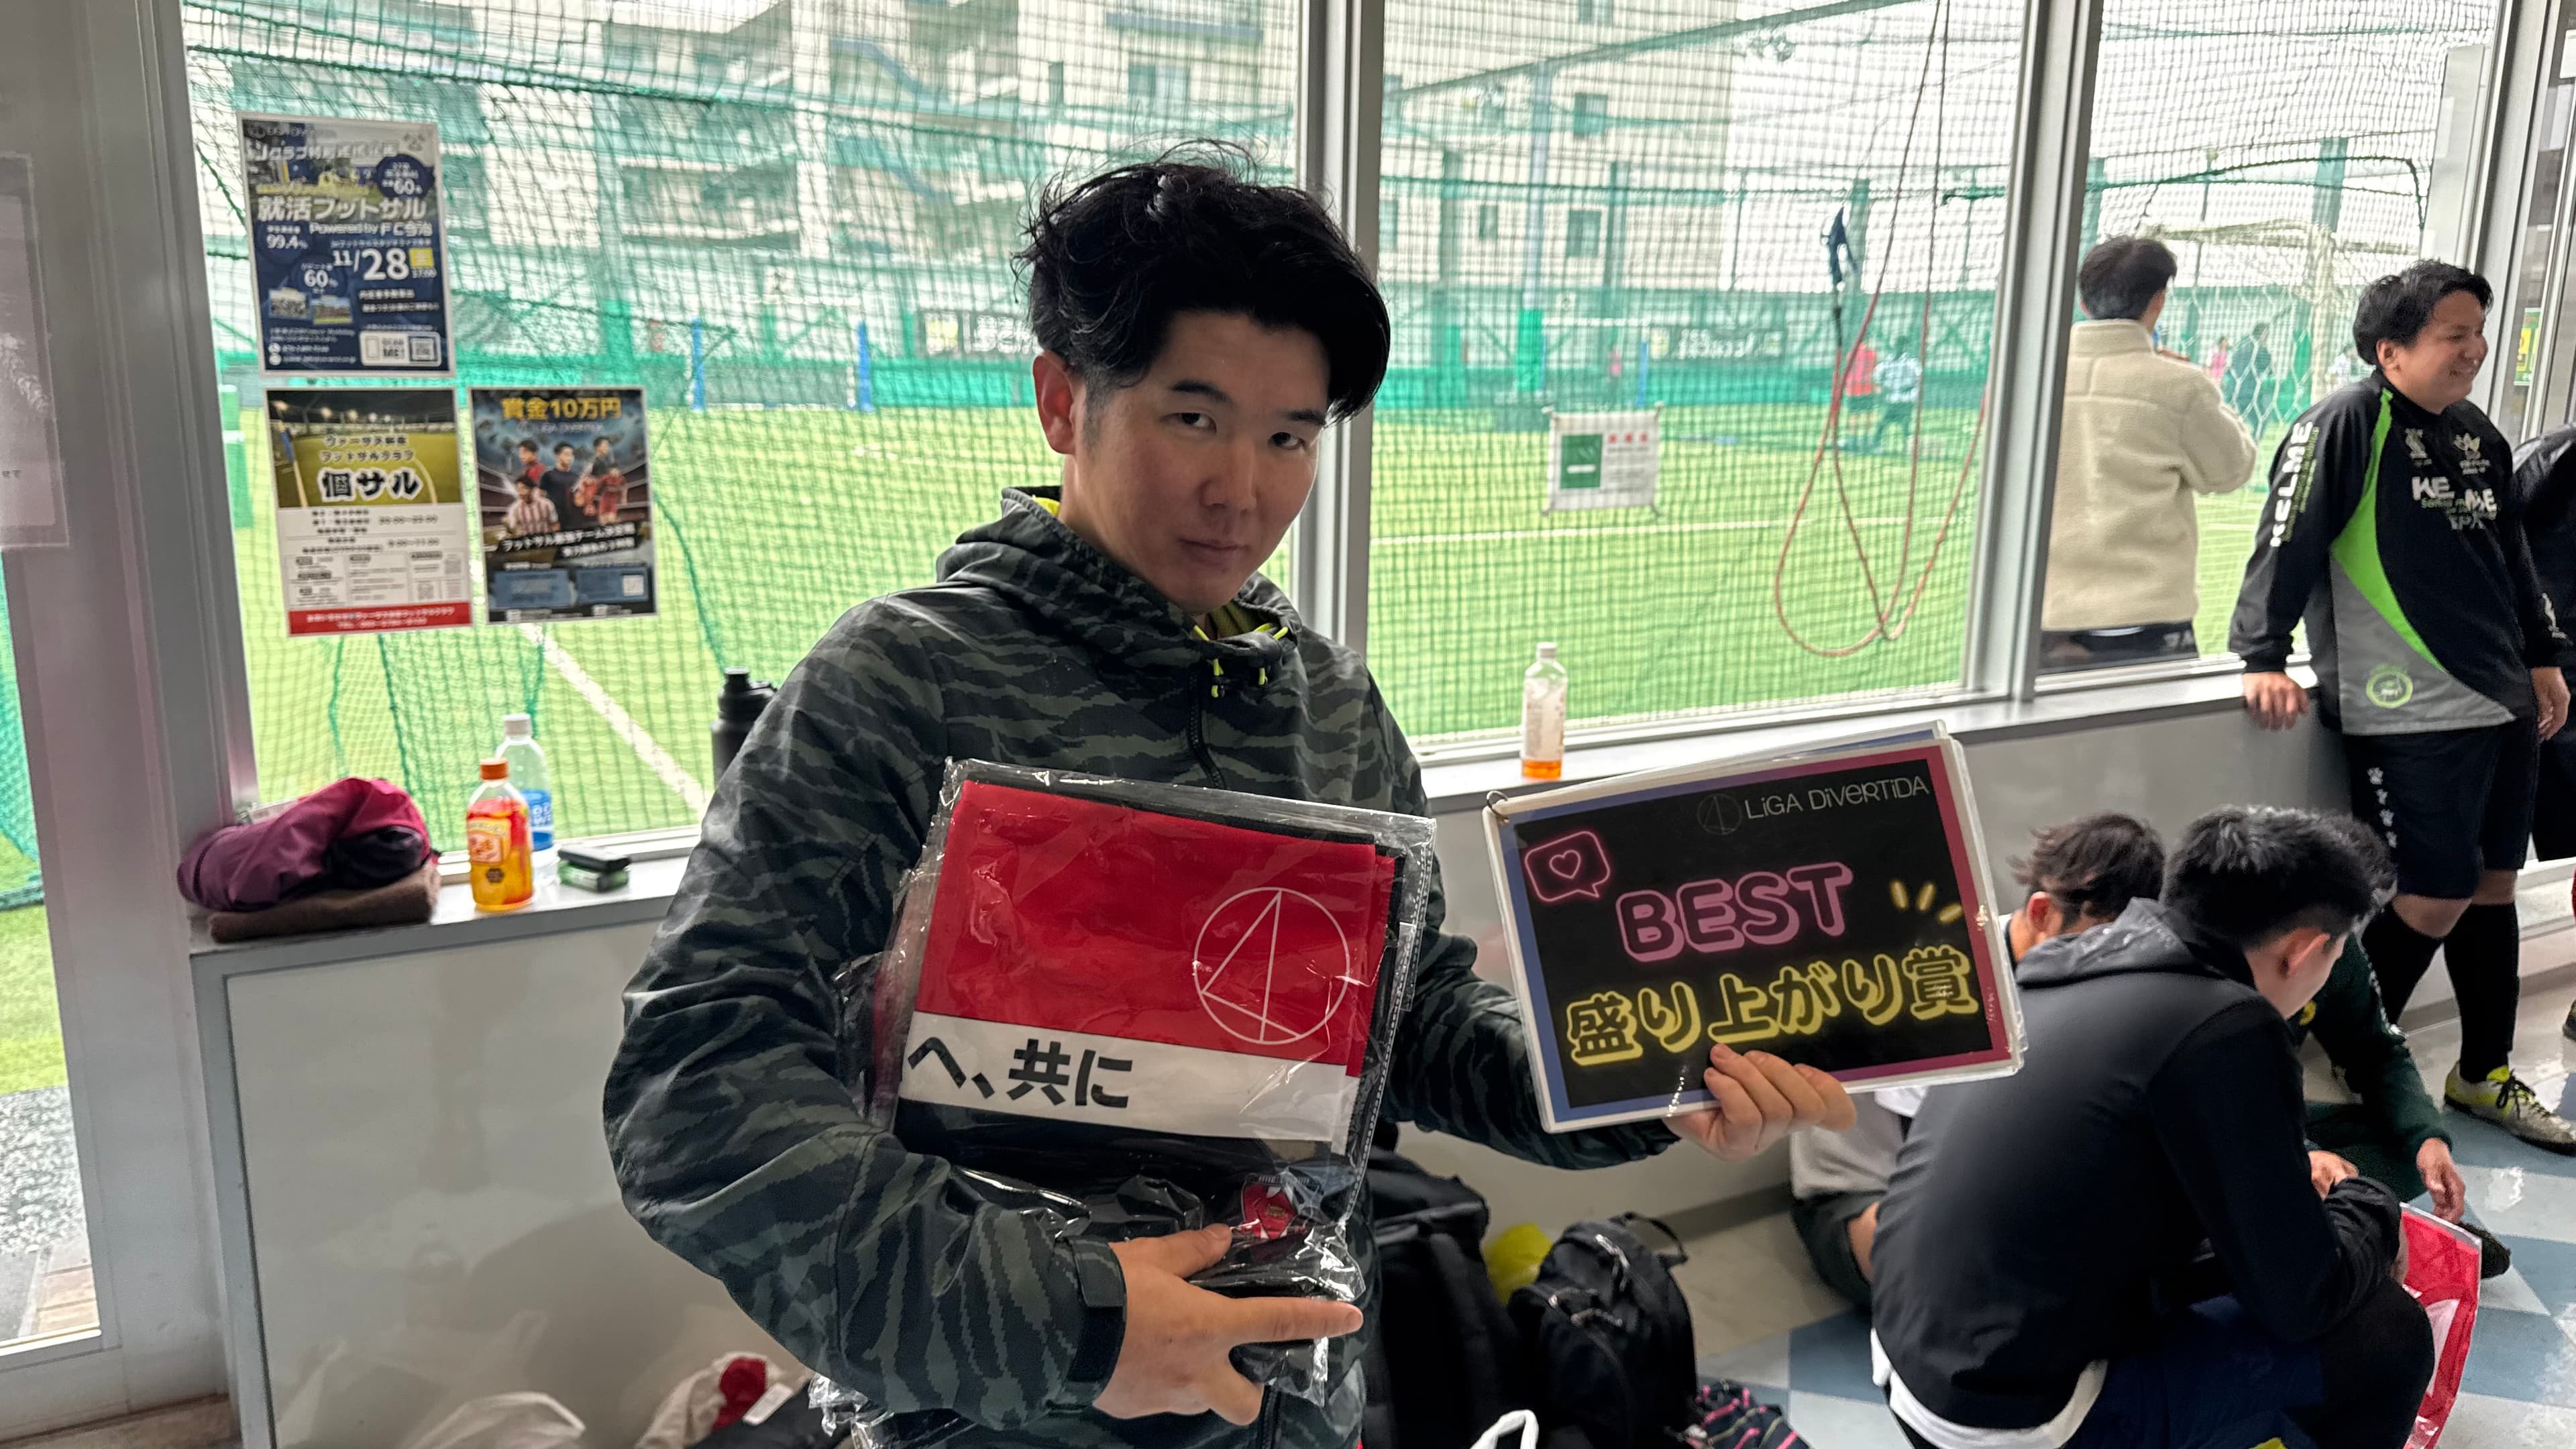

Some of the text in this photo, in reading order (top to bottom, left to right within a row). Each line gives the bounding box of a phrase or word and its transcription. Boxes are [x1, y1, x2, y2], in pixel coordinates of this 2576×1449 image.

[257, 196, 428, 221] 就活フットサル
[332, 248, 410, 280] 11/28
[500, 396, 622, 421] 賞金10万円
[319, 468, 422, 500] 個サル
[1616, 861, 1854, 963] BEST
[1566, 944, 1980, 1066] 盛り上がり賞
[908, 1036, 1133, 1108] へ、共に
